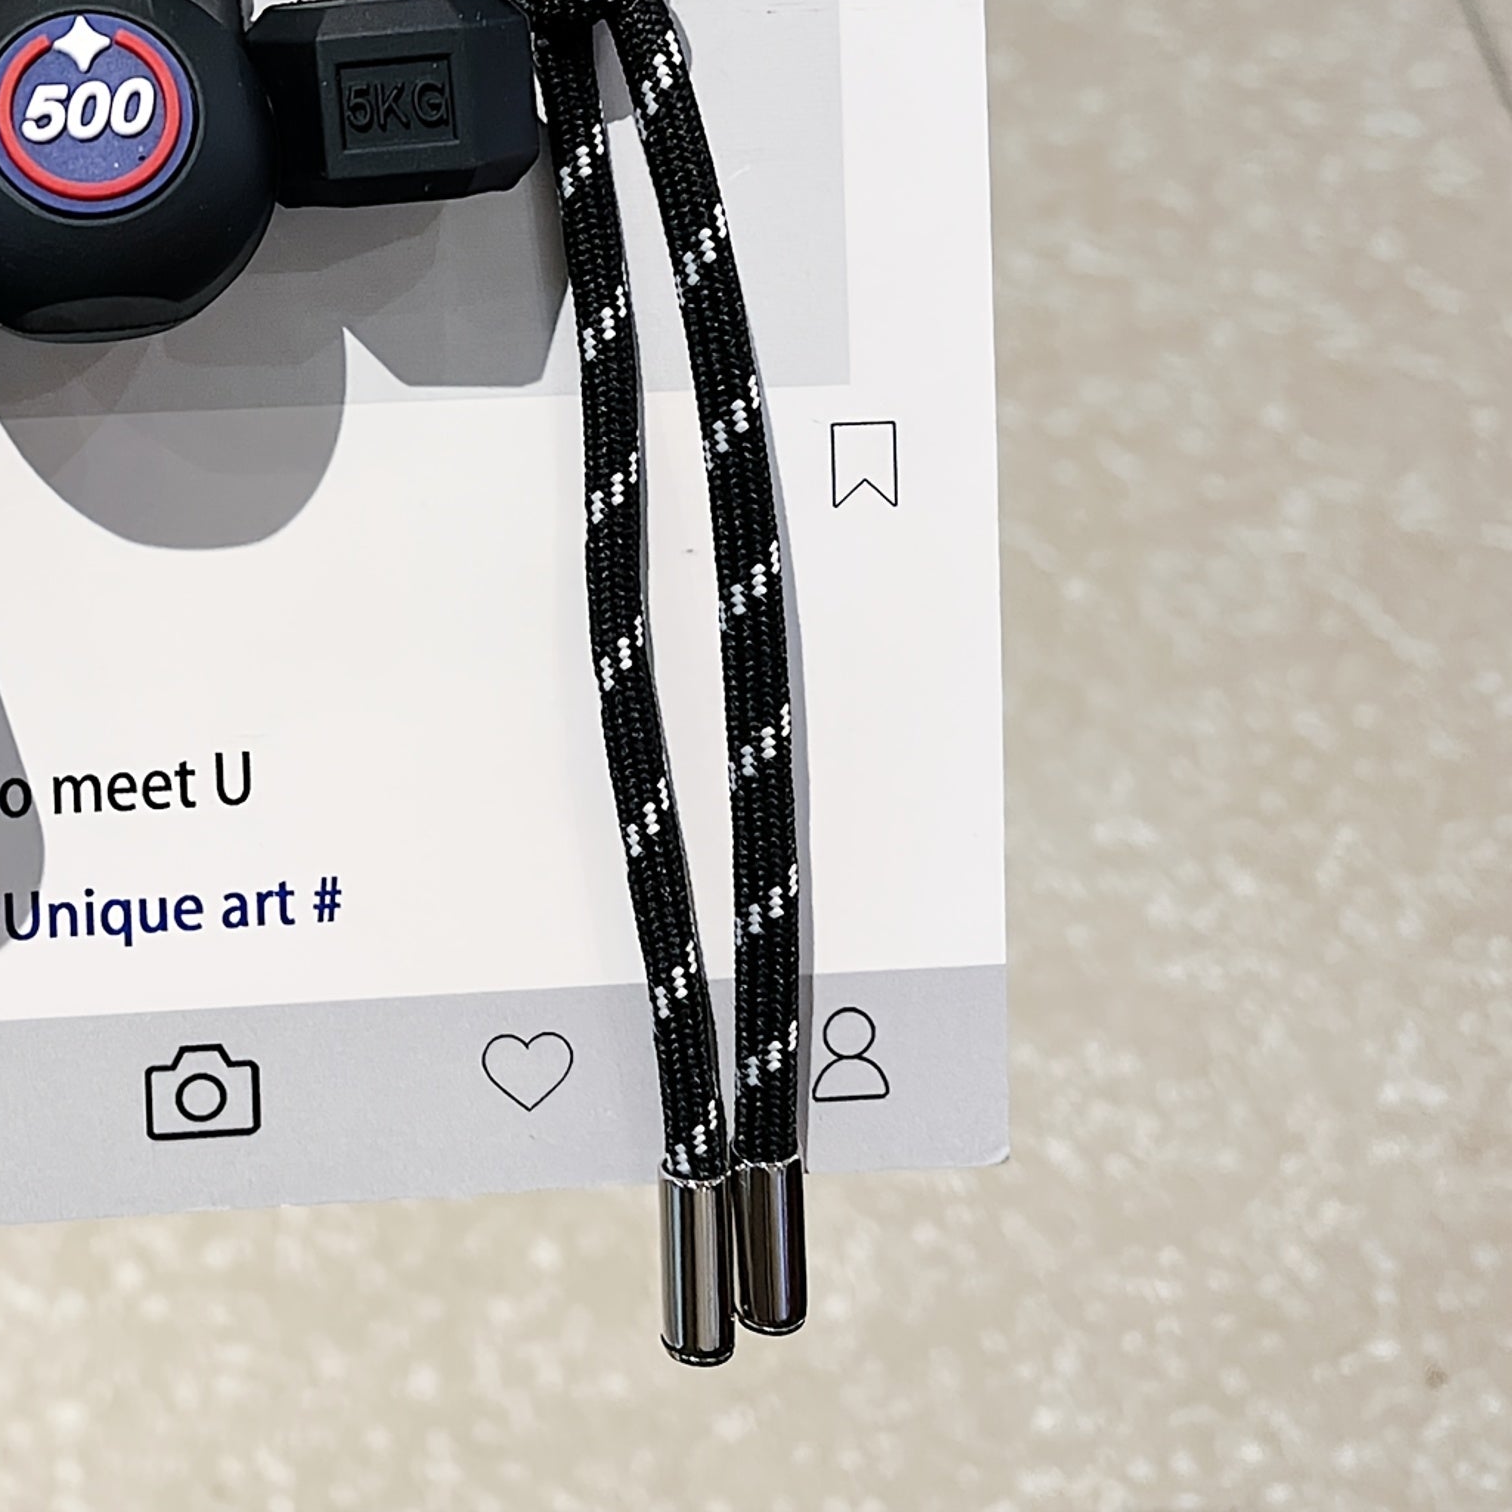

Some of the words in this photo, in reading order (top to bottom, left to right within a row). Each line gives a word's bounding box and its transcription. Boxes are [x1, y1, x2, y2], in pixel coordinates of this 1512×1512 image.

[20, 76, 157, 144] 500
[345, 79, 451, 134] 5KG
[51, 760, 198, 815] meet
[214, 750, 252, 807] U
[220, 880, 296, 930] art
